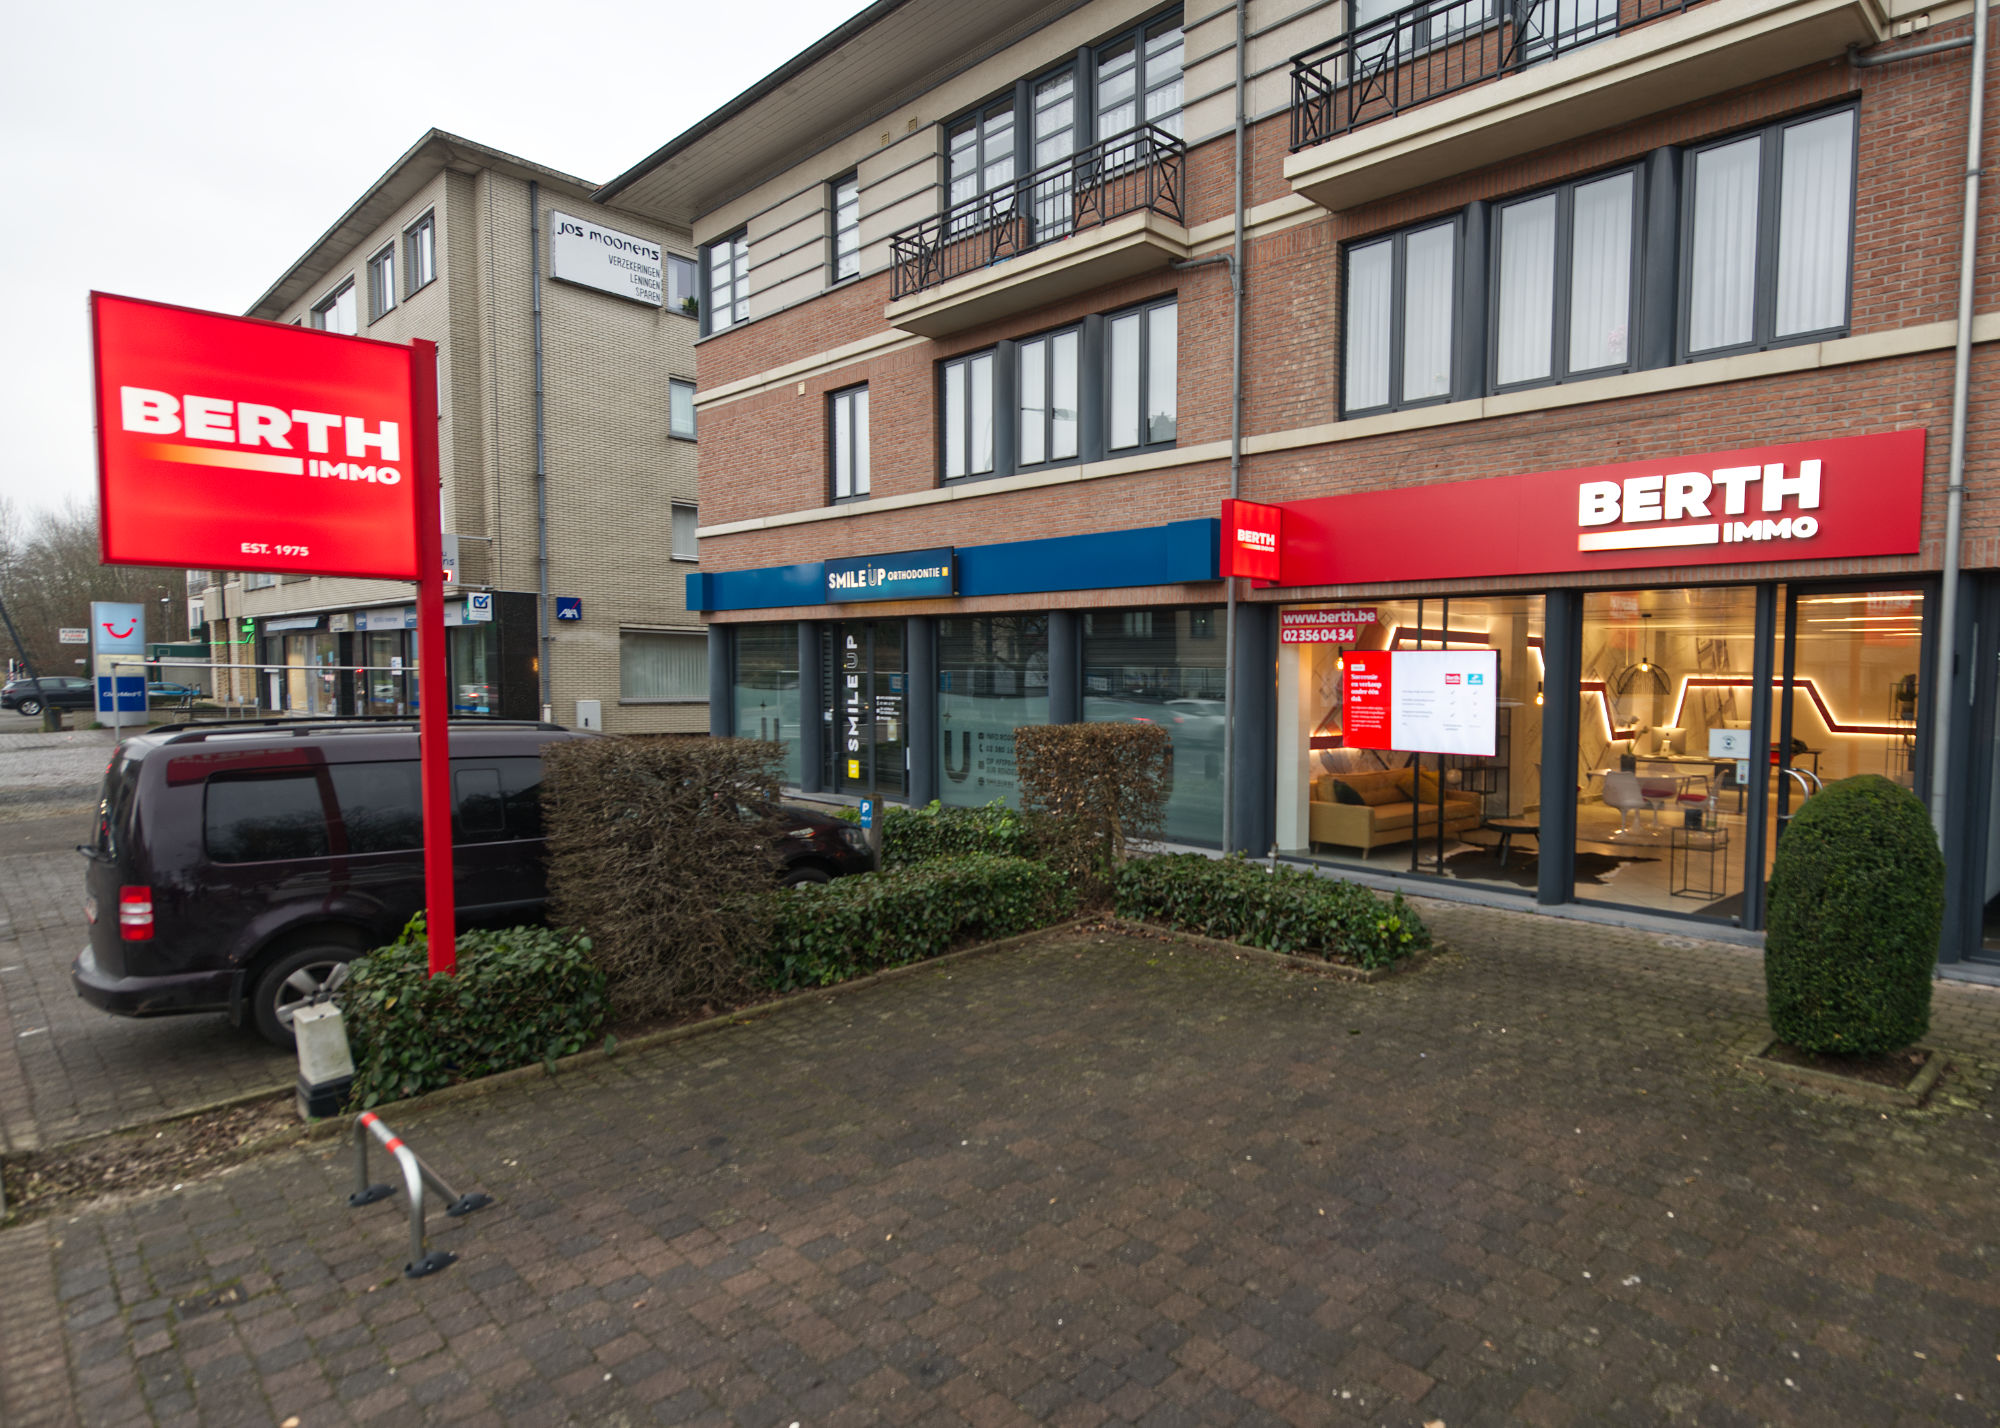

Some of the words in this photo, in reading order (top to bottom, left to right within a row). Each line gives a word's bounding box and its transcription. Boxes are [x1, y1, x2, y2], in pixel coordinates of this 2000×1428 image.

[608, 254, 661, 278] VERZEKERINGEN
[630, 273, 661, 290] LENINGEN
[635, 287, 661, 302] SPAREN
[120, 386, 400, 461] BERTH
[309, 459, 401, 485] IMMO
[1578, 459, 1822, 526] BERTH
[1237, 529, 1275, 546] BERTH
[1723, 516, 1818, 543] IMMO
[241, 543, 271, 554] EST.
[275, 545, 309, 556] 1975
[887, 567, 940, 581] ORTHODONTIE
[558, 608, 579, 619] AXA
[1283, 610, 1376, 624] www.berth.be
[1283, 629, 1298, 642] 02
[1298, 629, 1320, 642] 356
[1320, 628, 1337, 641] 04
[1337, 628, 1354, 641] 34
[846, 675, 859, 752] SMILE
[862, 802, 870, 813] P
